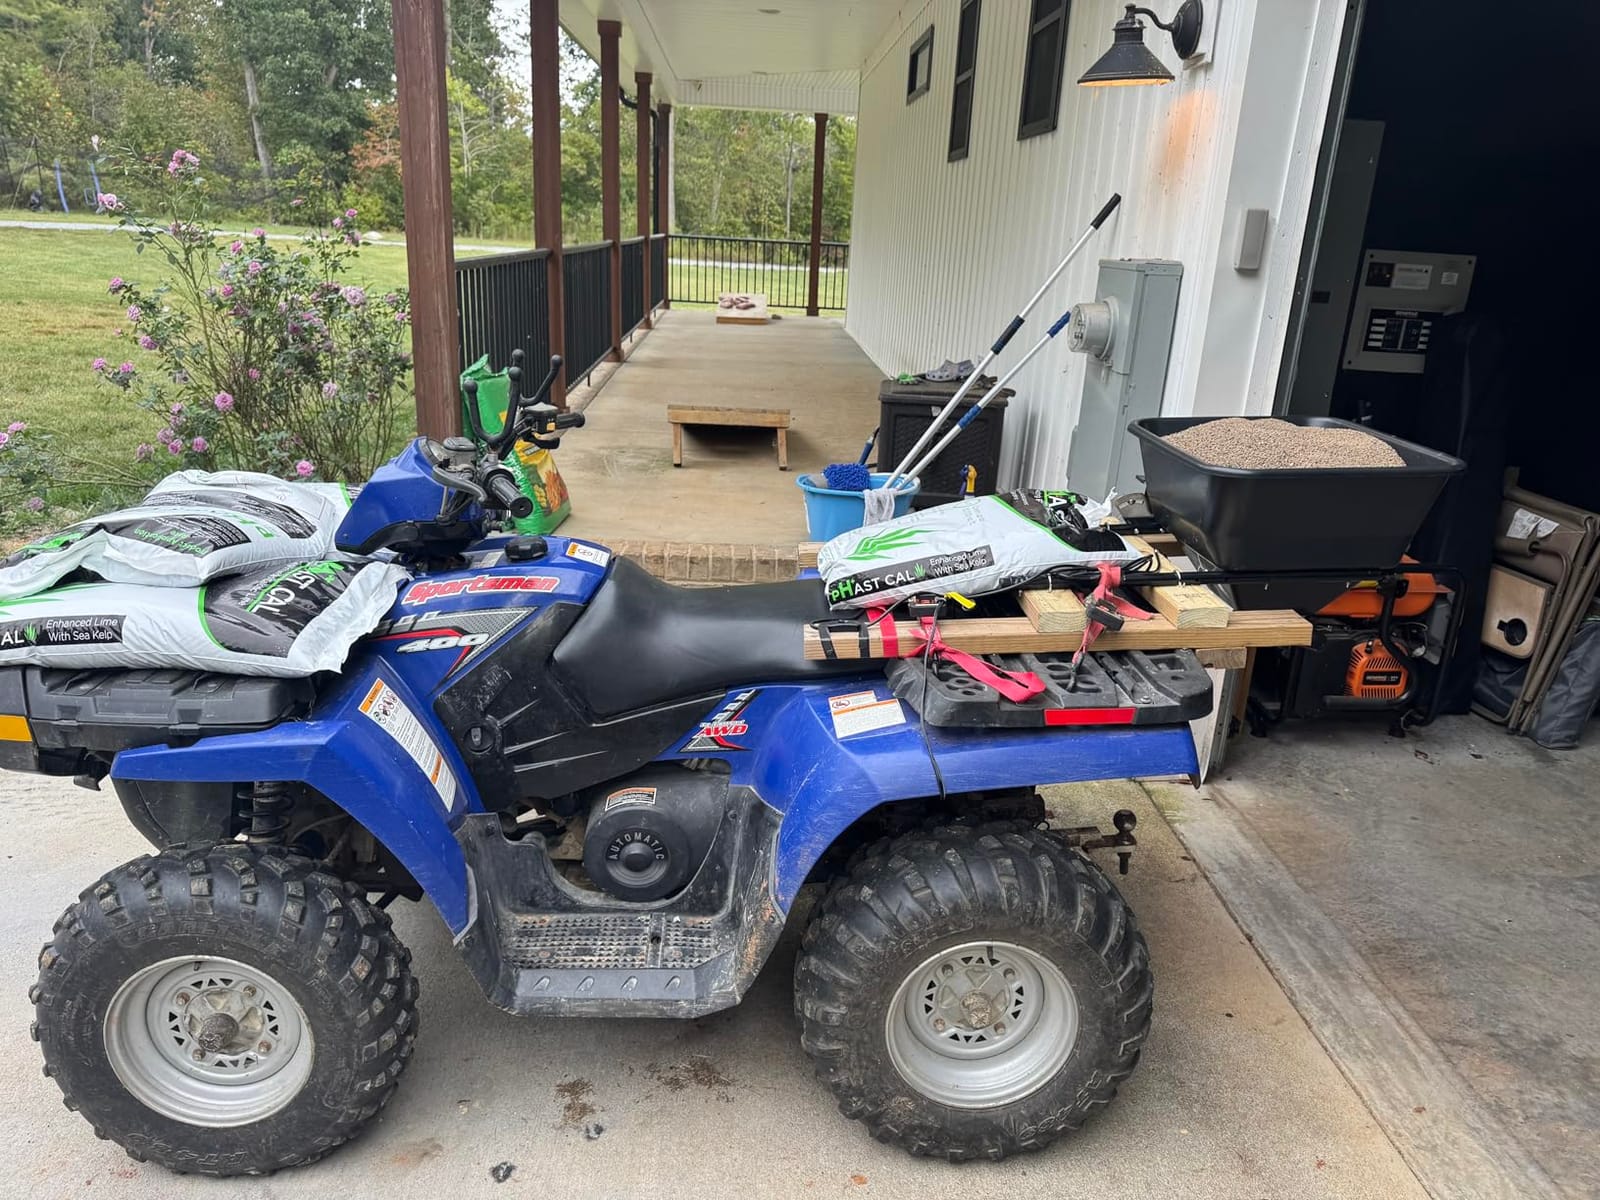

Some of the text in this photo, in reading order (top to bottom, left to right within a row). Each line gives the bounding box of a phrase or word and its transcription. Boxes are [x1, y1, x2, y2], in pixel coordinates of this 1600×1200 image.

[884, 570, 916, 586] CAL
[934, 565, 954, 578] With
[401, 575, 560, 606] Sportsman
[252, 587, 296, 613] CAL
[46, 616, 119, 629] Enhanced Lime
[48, 630, 113, 642] With Sea Kelp
[397, 632, 490, 653] 400
[692, 724, 749, 737] AWD
[609, 831, 665, 860] AUTOMATIC
